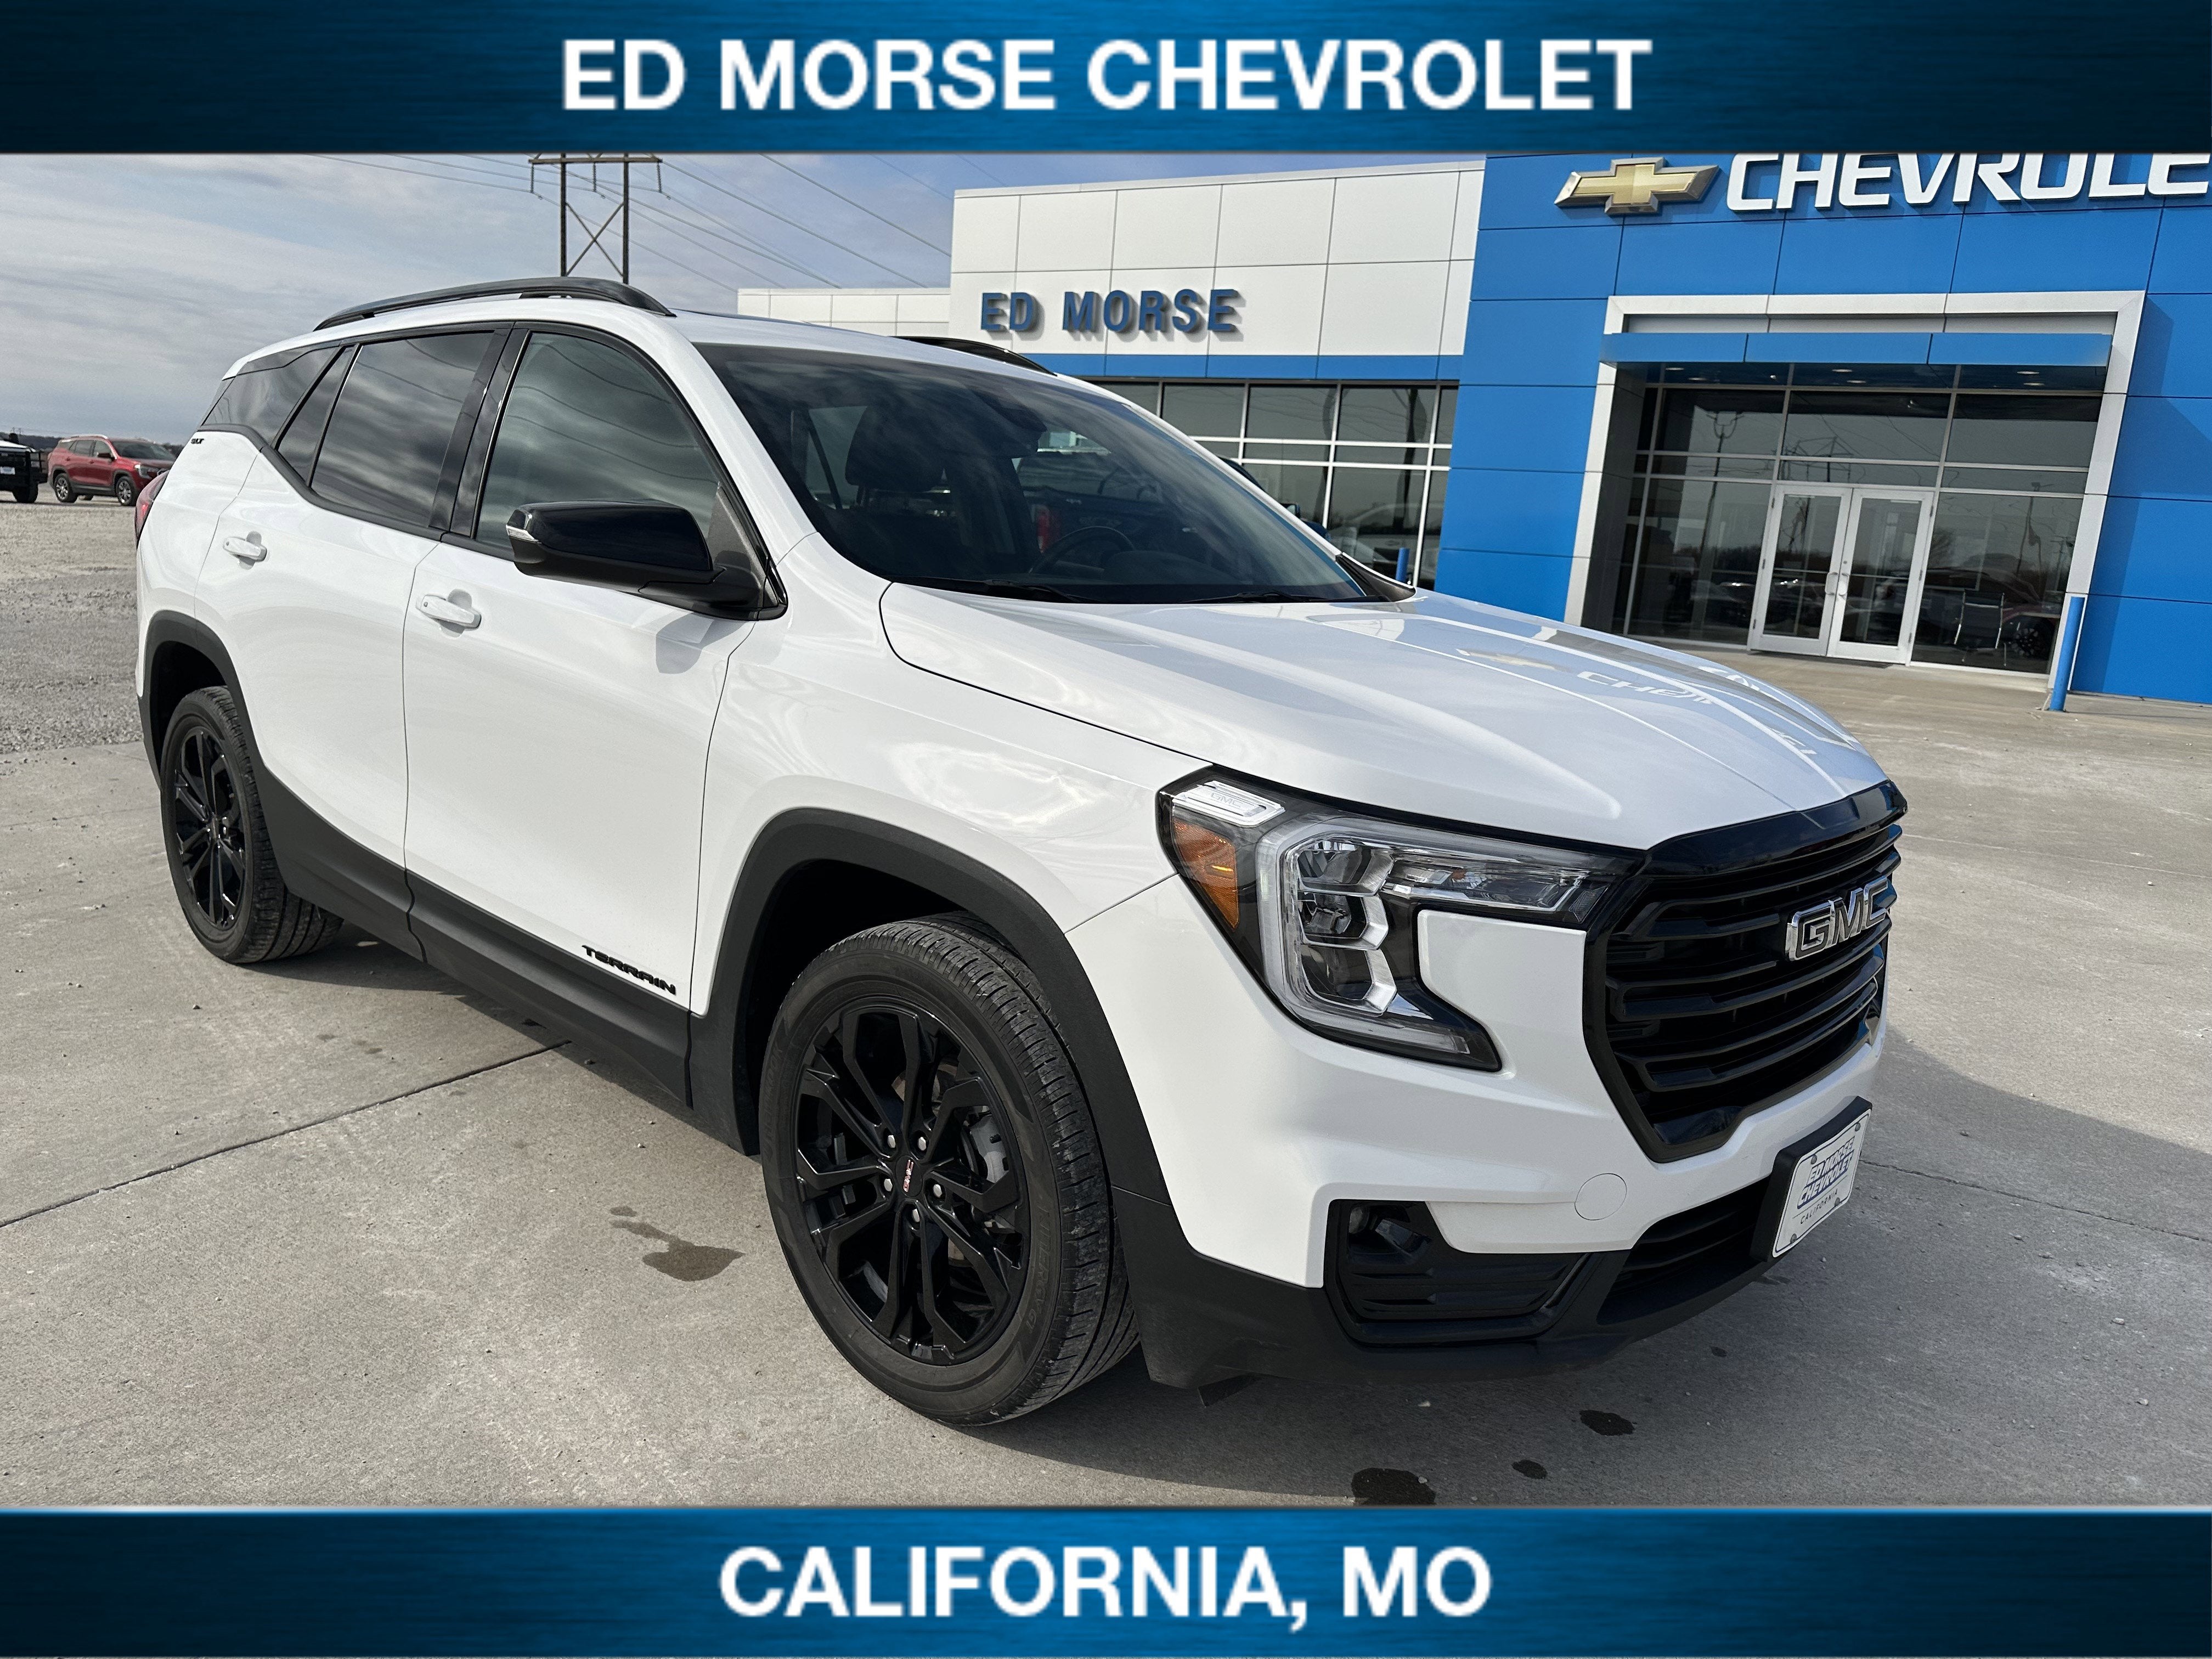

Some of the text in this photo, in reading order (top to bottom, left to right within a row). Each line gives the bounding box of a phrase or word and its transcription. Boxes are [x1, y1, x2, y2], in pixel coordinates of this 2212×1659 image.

[981, 289, 1241, 333] ED MORSE
[1211, 792, 1244, 809] GMC
[1785, 876, 1888, 961] GMC
[582, 945, 676, 996] TERRAIN
[903, 1159, 914, 1192] GMC
[1797, 1150, 1854, 1209] CHEVROLET
[1807, 1136, 1855, 1185] ED MORSE
[1800, 1188, 1838, 1224] CALIFORNIA
